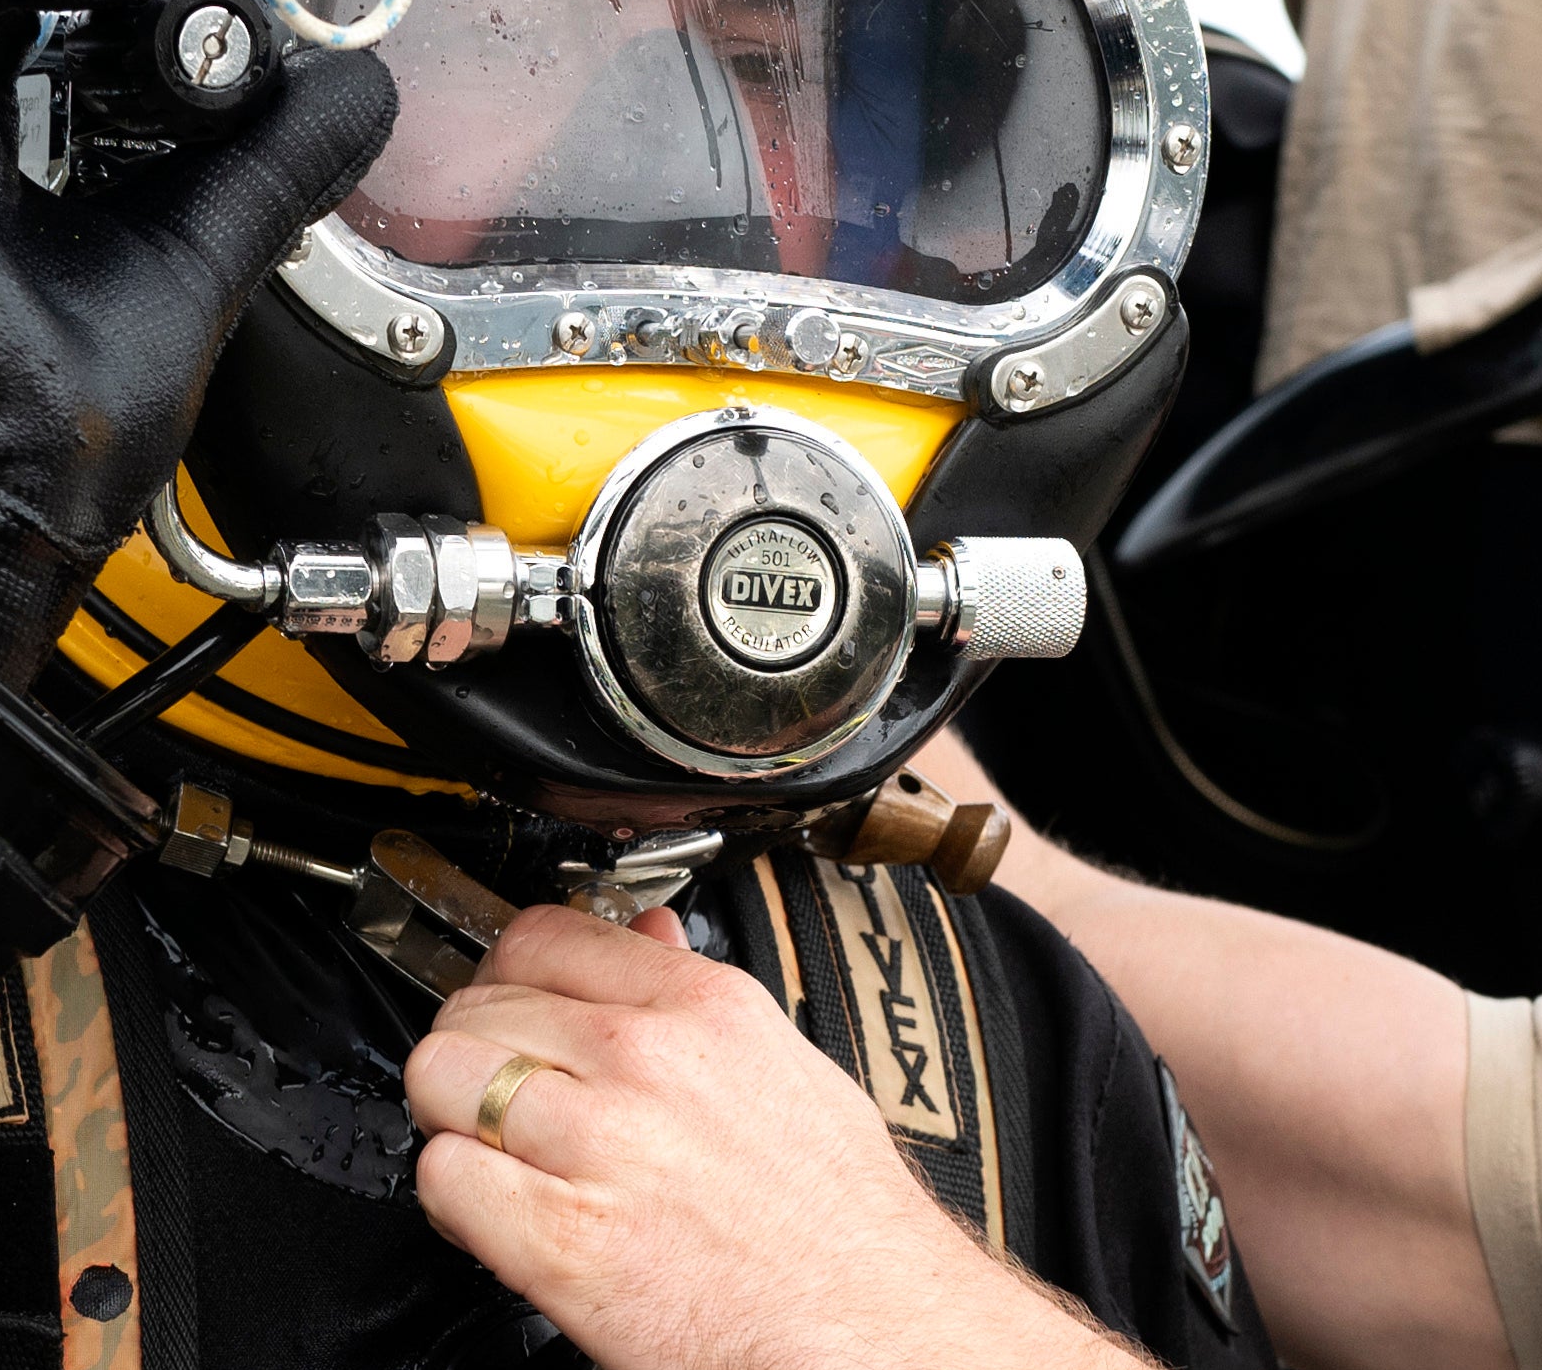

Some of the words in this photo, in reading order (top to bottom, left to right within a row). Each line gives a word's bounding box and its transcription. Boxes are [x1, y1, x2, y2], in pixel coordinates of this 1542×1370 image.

[727, 530, 821, 565] ULTRAFLOW
[761, 550, 791, 567] 501
[730, 573, 814, 607] DIVEX
[723, 616, 813, 652] REGULATOR
